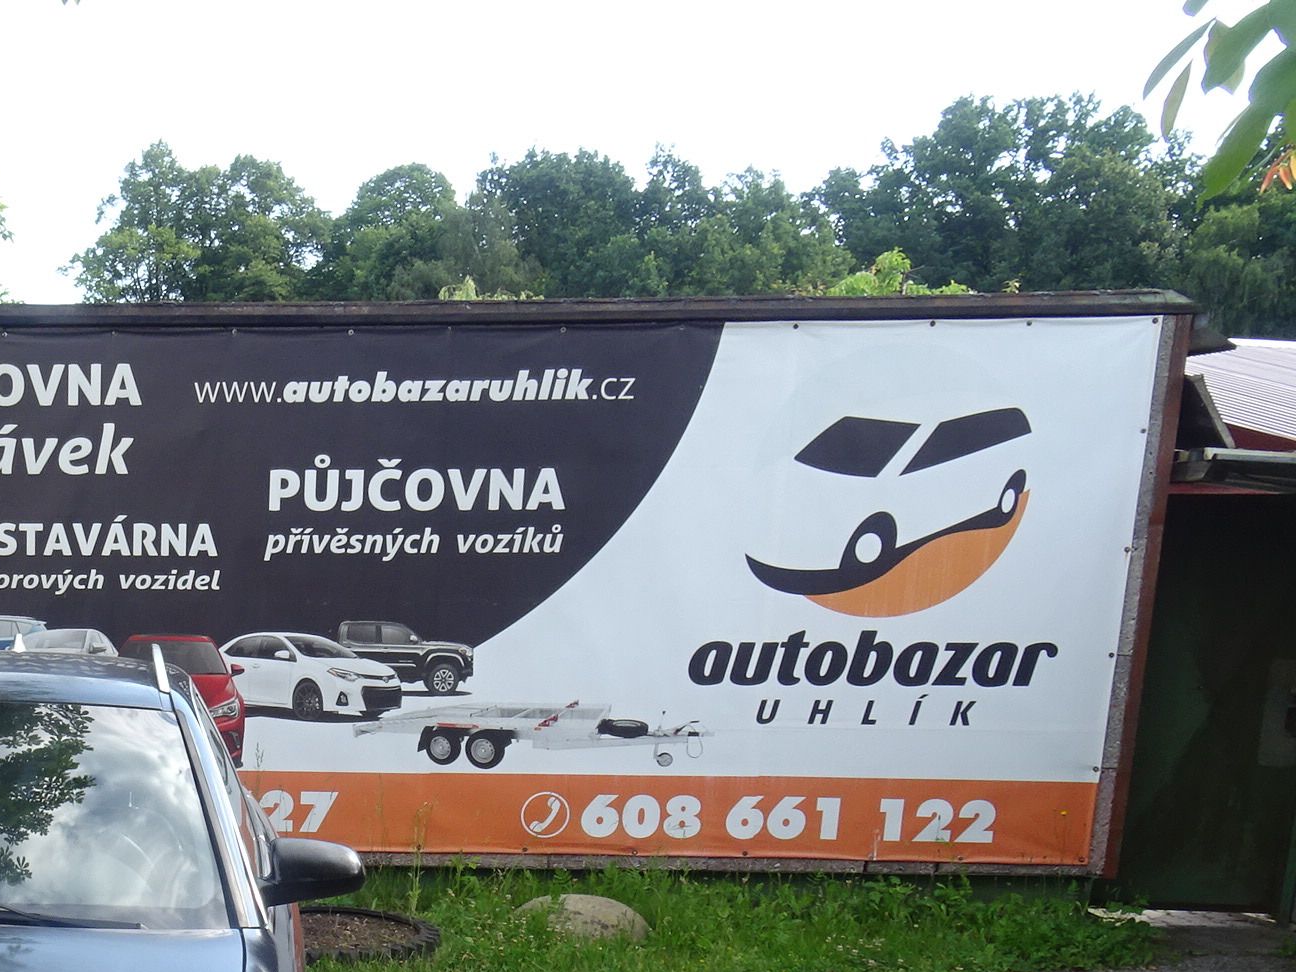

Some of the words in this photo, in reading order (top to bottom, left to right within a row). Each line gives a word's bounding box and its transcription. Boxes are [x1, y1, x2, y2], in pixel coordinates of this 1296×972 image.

[194, 367, 636, 404] www.autobazaruhlik.cz
[268, 454, 566, 512] PŮJČOVNA
[263, 526, 440, 562] přívěsných
[456, 523, 564, 554] vozíků
[119, 569, 222, 591] vozidel
[688, 629, 1059, 688] autobazar
[755, 693, 977, 727] UHLÍK
[246, 789, 339, 833] 27
[580, 794, 702, 839] 608
[725, 795, 841, 841] 661
[879, 798, 996, 844] 122
